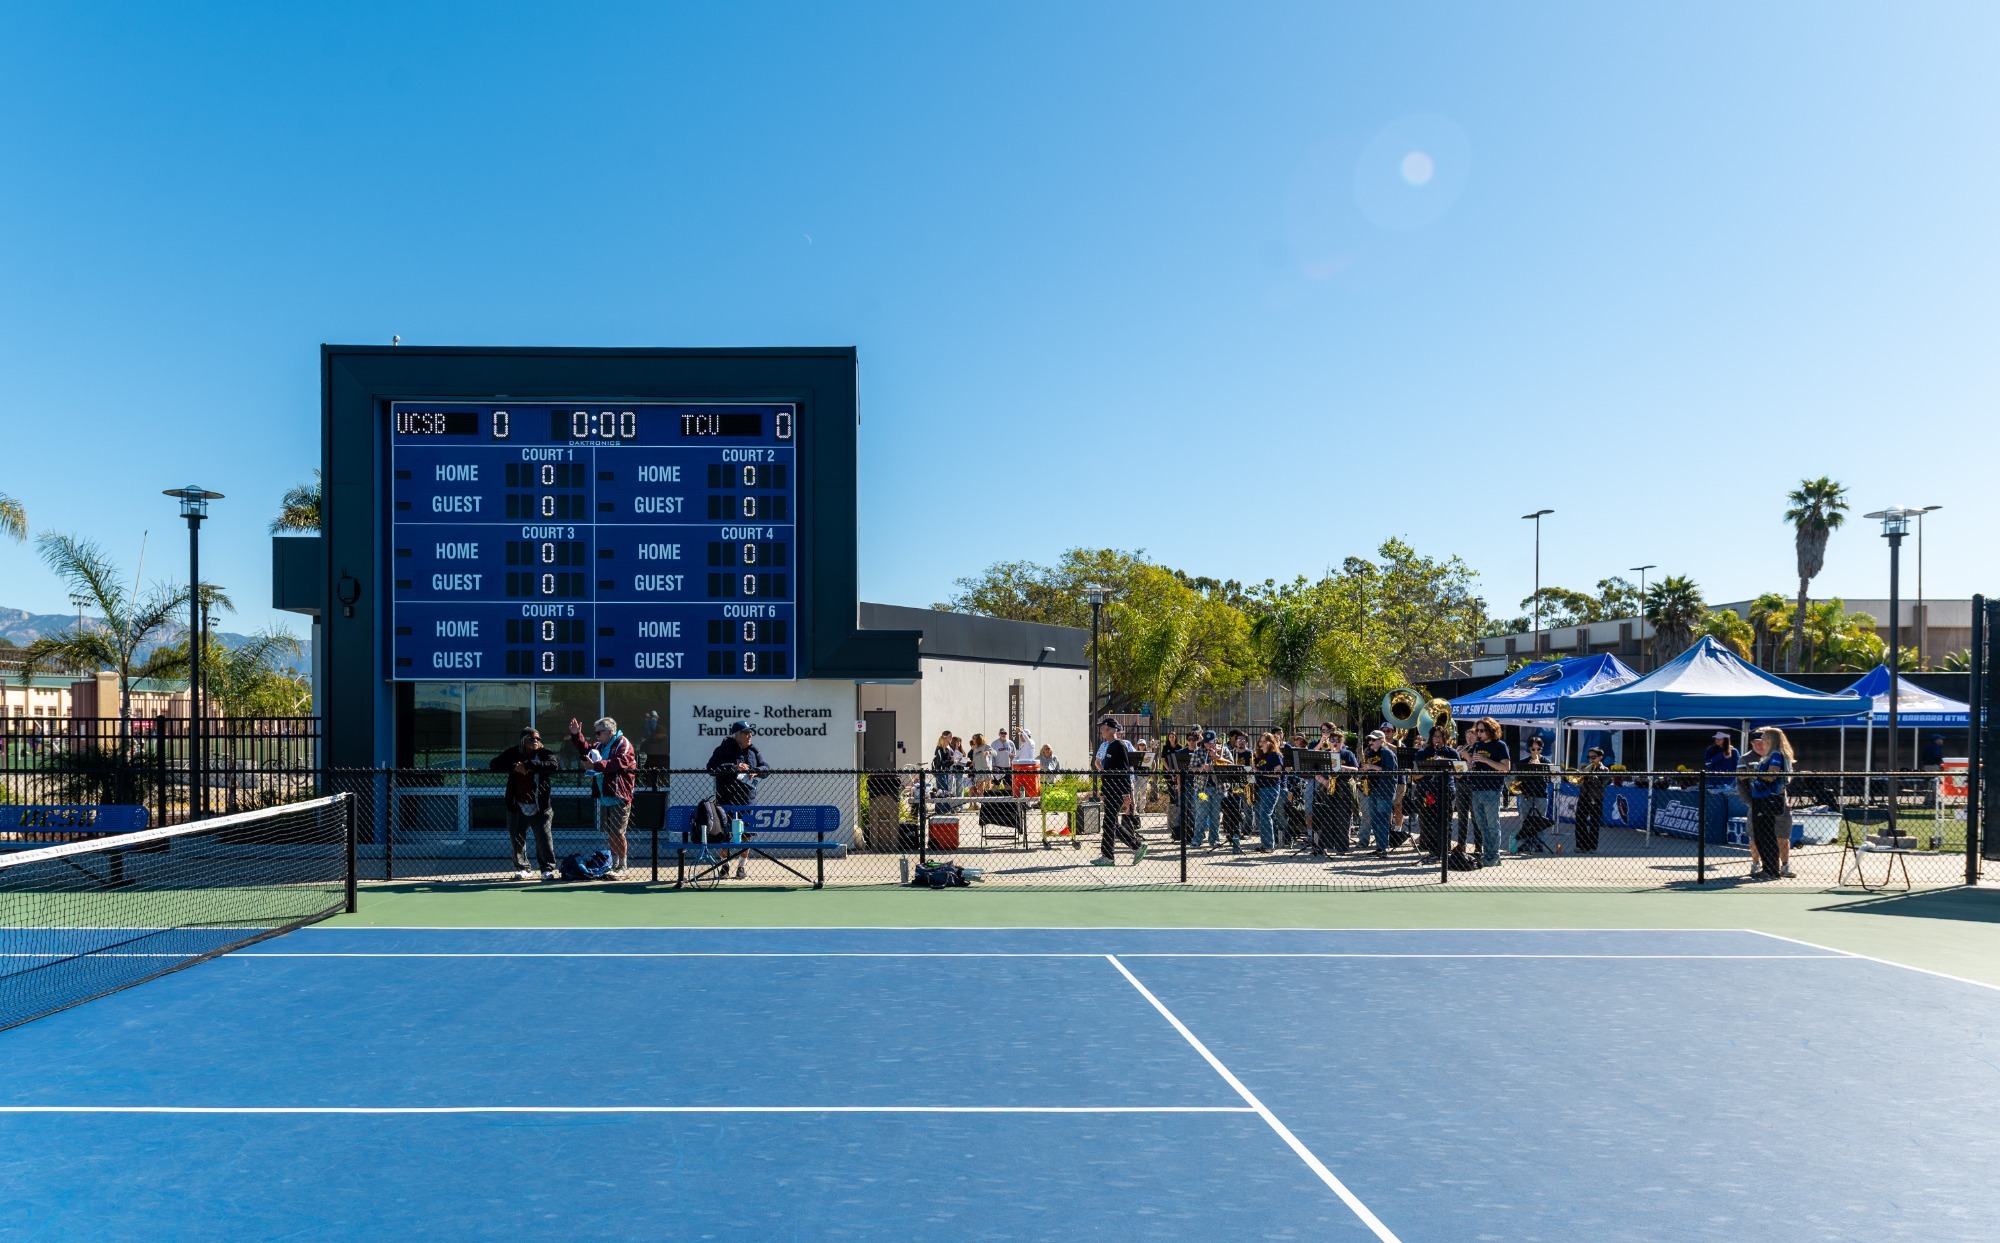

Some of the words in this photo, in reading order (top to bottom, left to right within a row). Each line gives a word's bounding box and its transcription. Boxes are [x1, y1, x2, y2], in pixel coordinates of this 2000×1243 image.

[398, 413, 445, 433] UCSB
[494, 412, 508, 437] 0
[574, 412, 635, 437] 0:00
[682, 415, 718, 435] TCU
[777, 413, 791, 438] 0
[522, 448, 563, 460] COURT
[568, 449, 572, 460] 1
[723, 449, 763, 461] COURT
[768, 450, 774, 461] 2
[436, 465, 478, 481] HOME
[542, 465, 553, 484] 0
[639, 466, 680, 482] HOME
[744, 466, 755, 485] 0
[433, 496, 482, 512] GUEST
[543, 496, 554, 515] 0
[635, 497, 683, 513] GUEST
[744, 497, 755, 516] 0
[523, 527, 564, 538] COURT
[568, 527, 574, 539] 3
[722, 527, 763, 539] COURT
[767, 528, 773, 539] 4
[437, 543, 478, 559] HOME
[543, 543, 554, 562] 0
[639, 544, 680, 559] HOME
[744, 544, 755, 563] 0
[433, 574, 482, 590] GUEST
[543, 574, 554, 593] 0
[635, 575, 683, 591] GUEST
[744, 575, 755, 594] 0
[523, 605, 563, 616] COURT
[568, 605, 574, 616] 5
[724, 605, 765, 617] COURT
[769, 606, 775, 617] 6
[437, 621, 478, 637] HOME
[543, 621, 554, 640] 0
[639, 622, 680, 637] HOME
[744, 622, 755, 640] 0
[433, 652, 482, 668] GUEST
[543, 652, 554, 671] 0
[635, 653, 684, 668] GUEST
[744, 652, 755, 671] 0
[692, 705, 751, 722] Maguire
[763, 704, 832, 718] Rotheram
[1468, 703, 1487, 715] SANTA
[1488, 703, 1517, 714] BARBARA
[1518, 702, 1555, 714] ATHLETICS
[1873, 714, 1900, 722] SAN
[1902, 714, 1943, 722] BARBARA
[698, 723, 732, 736] Fami
[751, 722, 828, 736] Scoreboard
[18, 808, 98, 828] UCSB
[754, 809, 792, 828] SB
